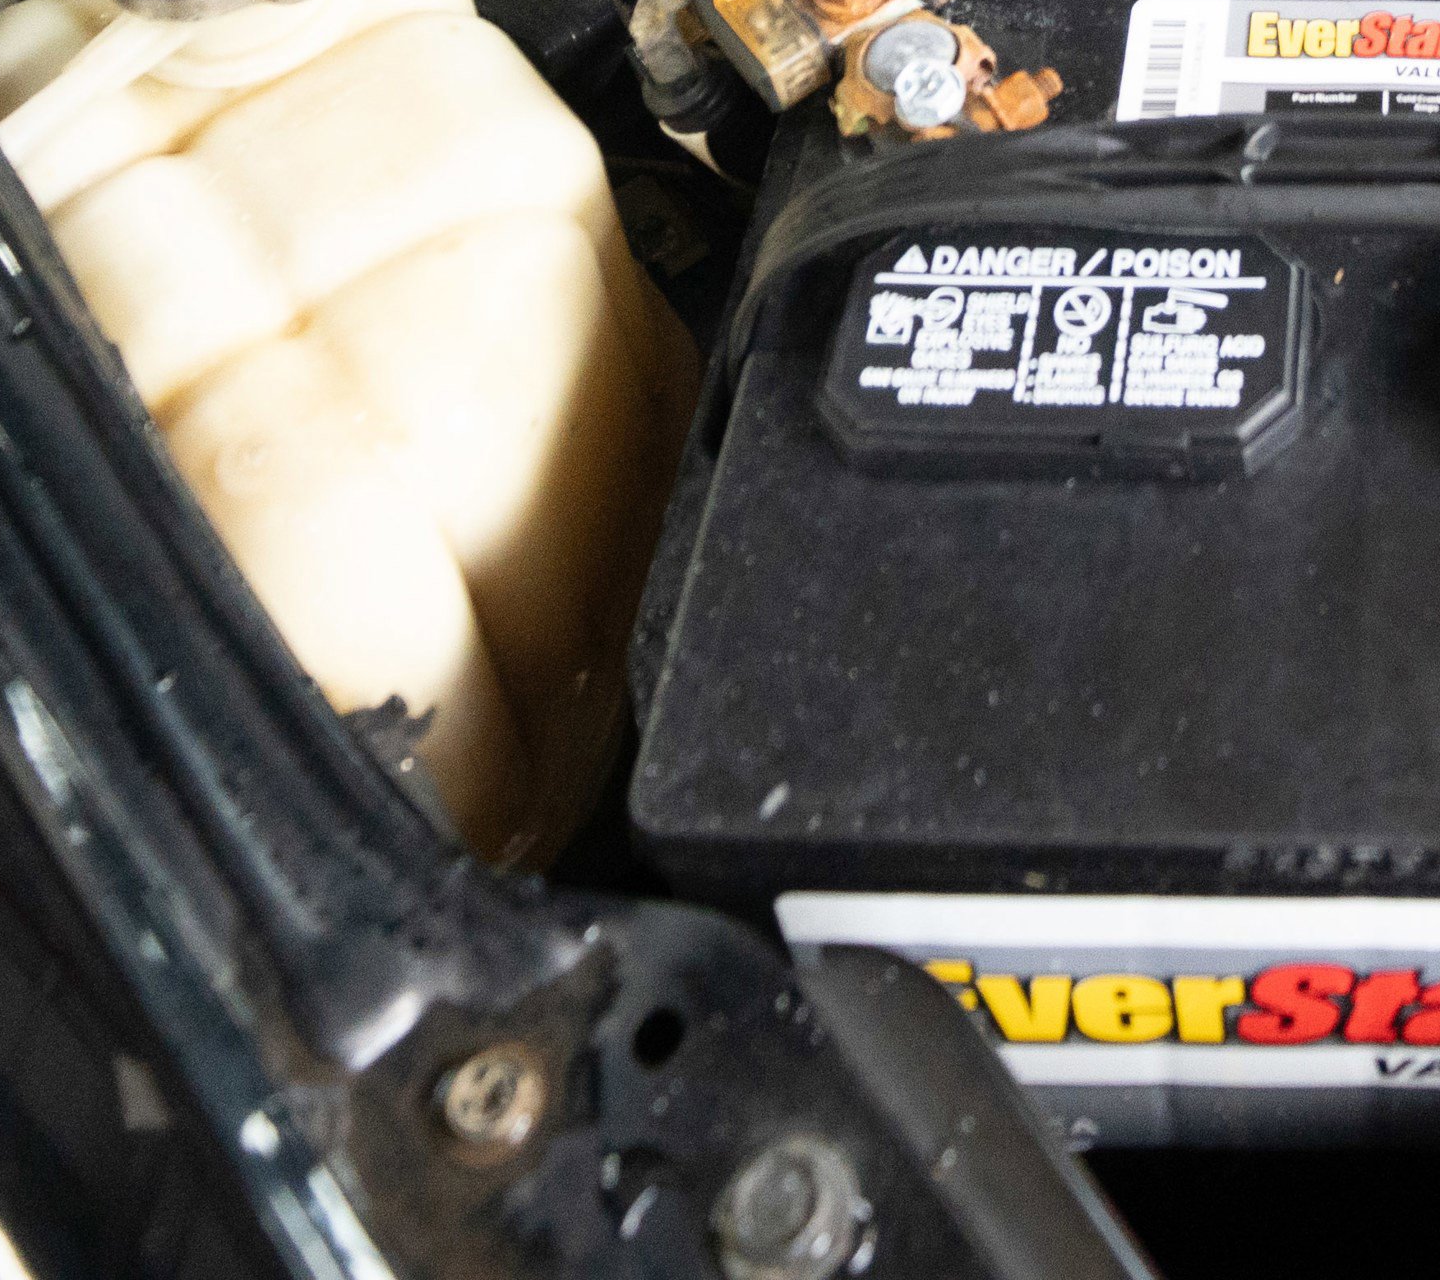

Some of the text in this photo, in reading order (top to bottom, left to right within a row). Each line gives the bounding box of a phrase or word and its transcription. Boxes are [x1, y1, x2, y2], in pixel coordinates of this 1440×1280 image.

[1291, 92, 1358, 104] Part Number
[931, 246, 1075, 277] DANGER
[1112, 248, 1241, 279] POISON
